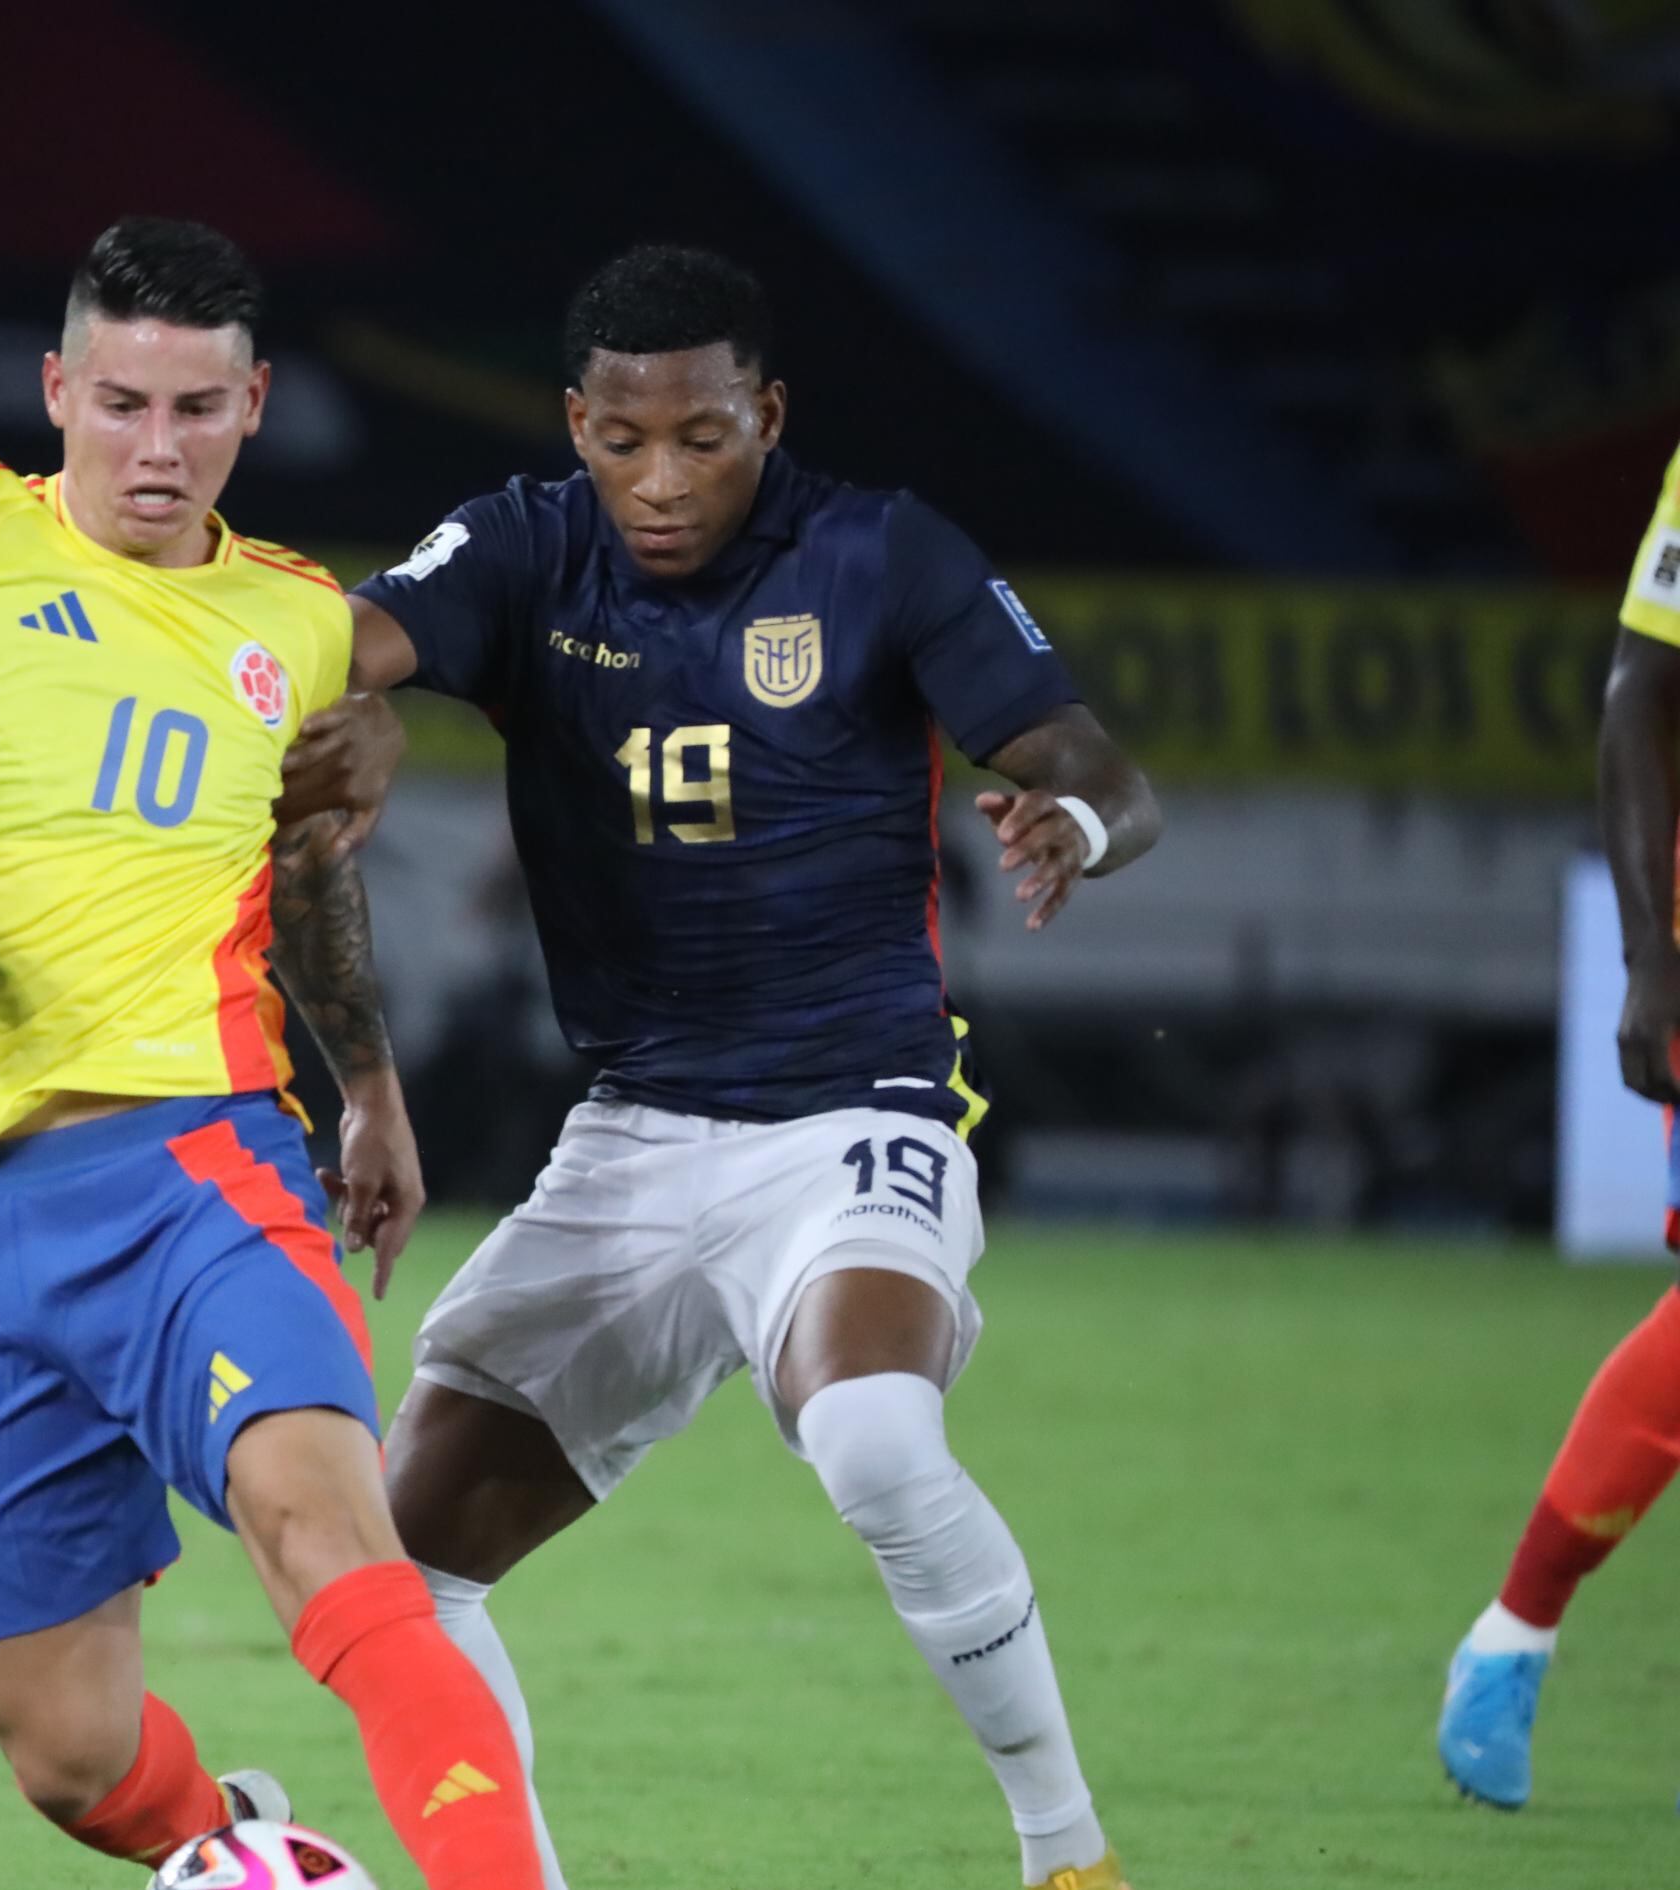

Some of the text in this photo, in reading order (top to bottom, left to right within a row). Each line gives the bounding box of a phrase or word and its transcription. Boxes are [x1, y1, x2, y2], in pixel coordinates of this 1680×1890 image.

[91, 695, 209, 828] 10
[615, 723, 736, 845] 19
[829, 1203, 943, 1244] marathon
[842, 1135, 948, 1222] 19
